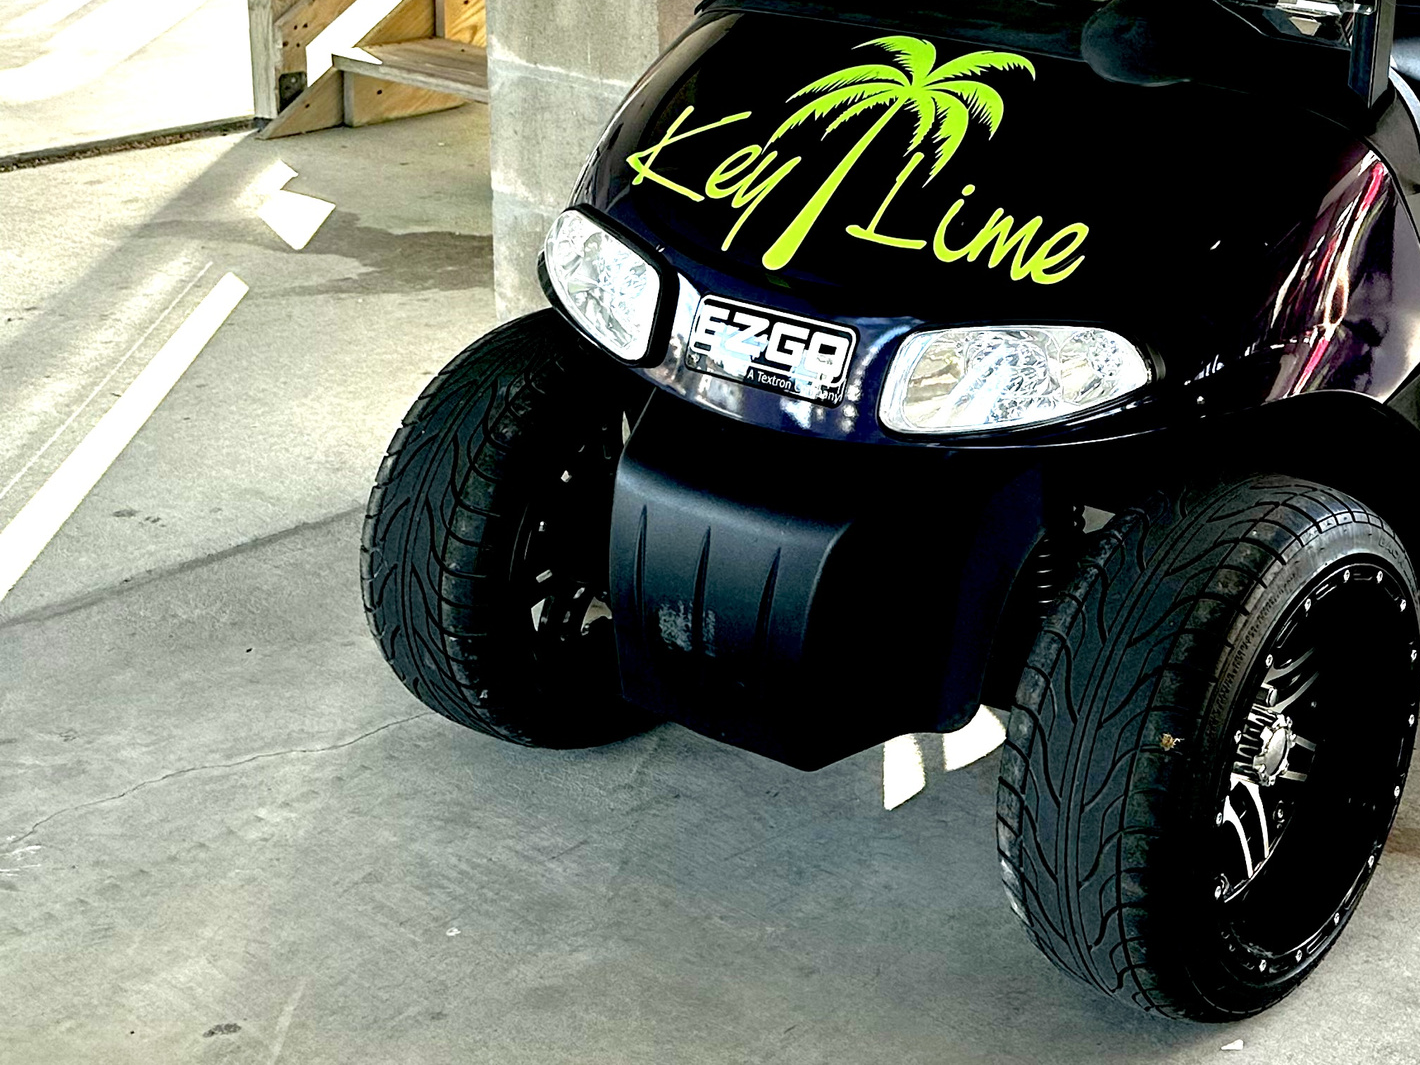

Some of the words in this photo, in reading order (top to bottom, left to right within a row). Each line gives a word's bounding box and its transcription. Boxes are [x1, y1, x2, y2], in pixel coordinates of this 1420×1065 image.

[626, 106, 801, 252] Key
[845, 152, 1090, 285] Lime
[747, 368, 755, 381] A
[757, 372, 792, 391] Textron
